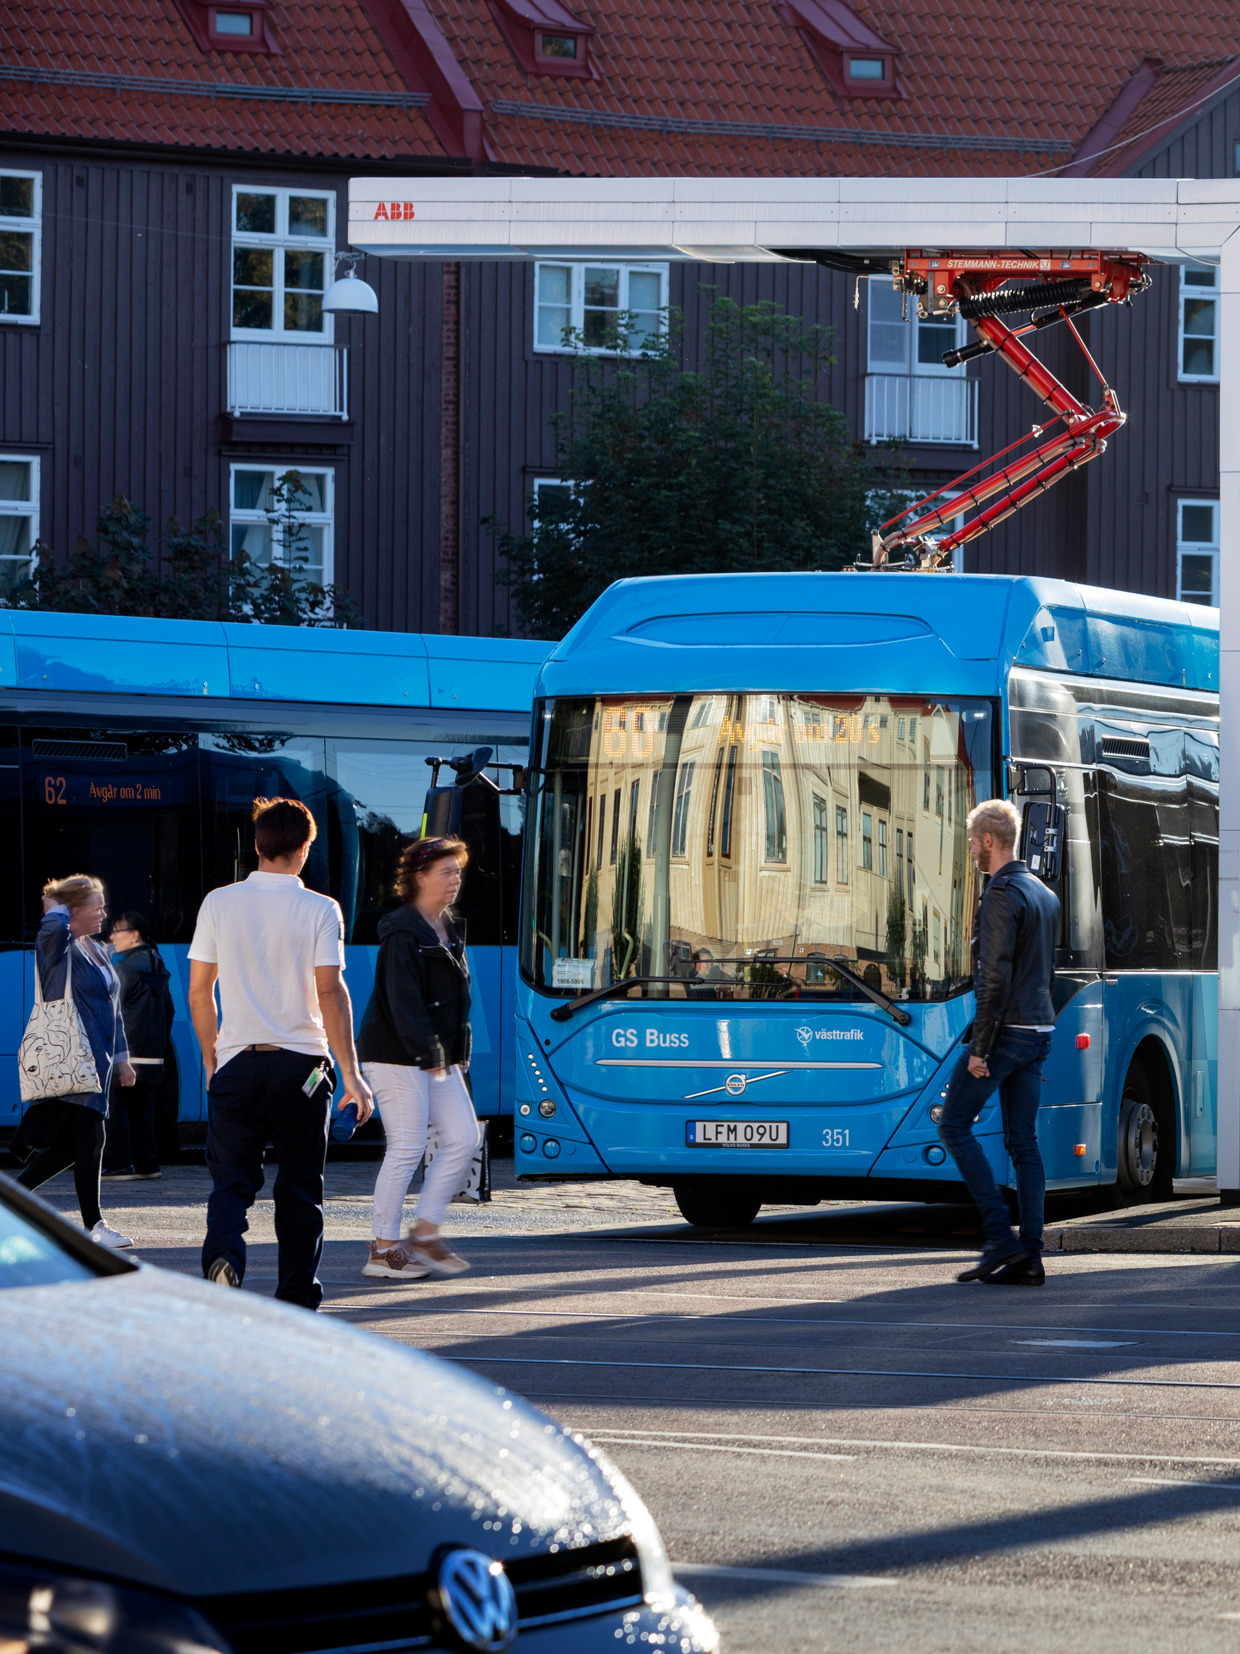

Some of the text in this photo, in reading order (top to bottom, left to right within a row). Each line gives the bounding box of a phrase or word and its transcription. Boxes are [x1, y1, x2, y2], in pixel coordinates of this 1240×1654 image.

[373, 202, 415, 220] ABB
[947, 259, 1039, 269] STEMMANN-TECHNIK
[604, 707, 654, 757] 60
[835, 715, 863, 744] 20
[868, 723, 881, 744] s
[45, 776, 161, 805] 62 Avgår om 2 min
[611, 1028, 689, 1048] GS Buss
[815, 1028, 864, 1041] västtrafik
[703, 1124, 779, 1142] LFM 09U
[822, 1128, 850, 1147] 351
